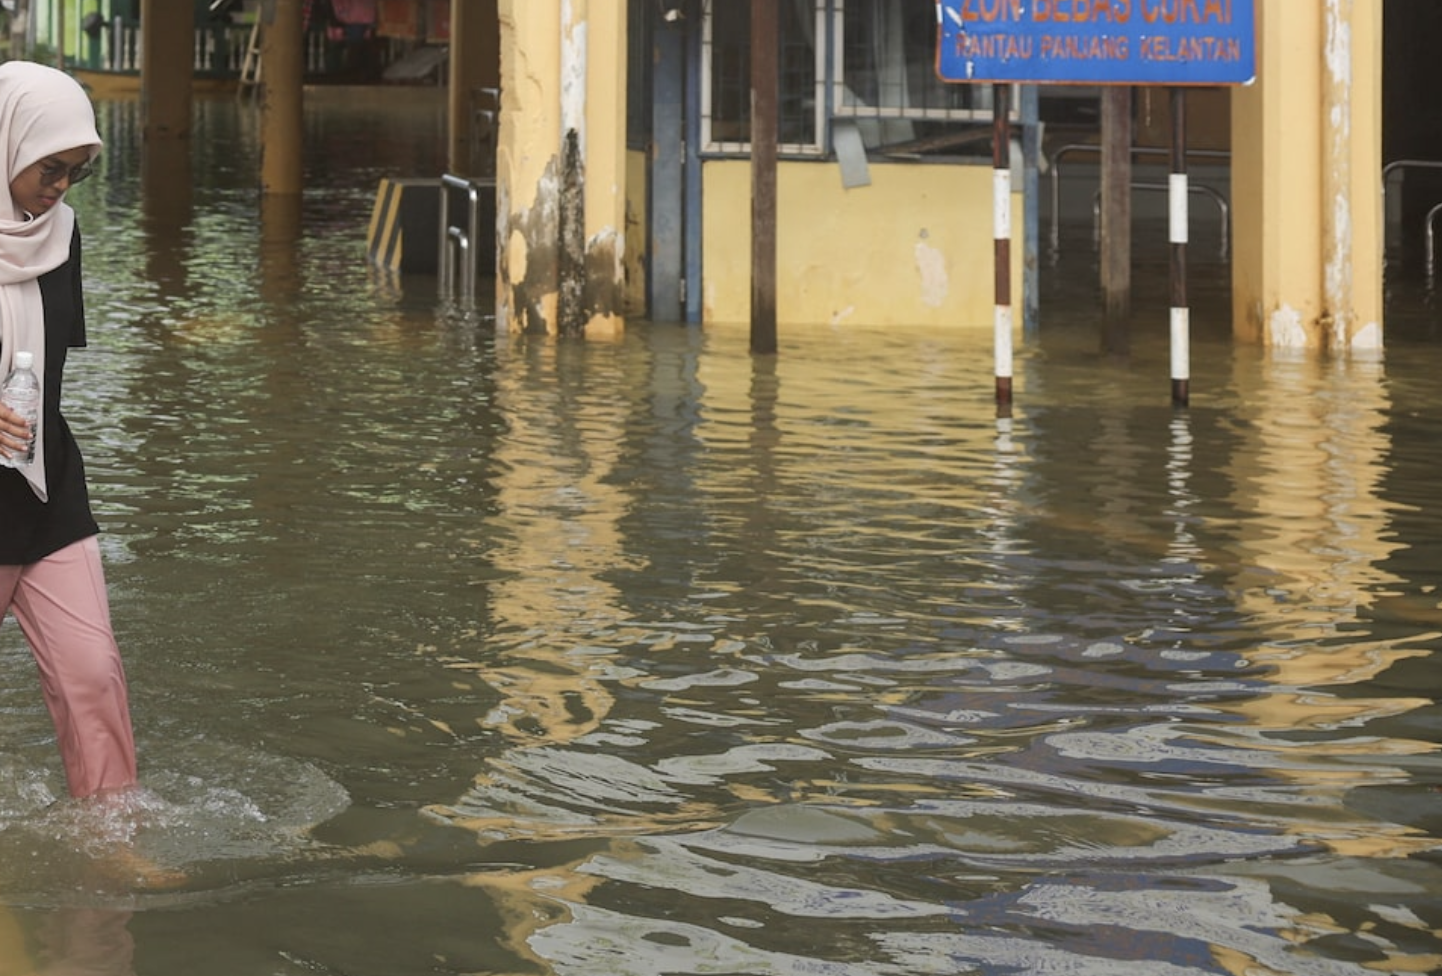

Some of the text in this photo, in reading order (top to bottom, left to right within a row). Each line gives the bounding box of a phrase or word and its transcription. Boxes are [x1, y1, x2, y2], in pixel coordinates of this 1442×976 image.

[955, 33, 1240, 61] RANTAU PANJANG KELANTAN
